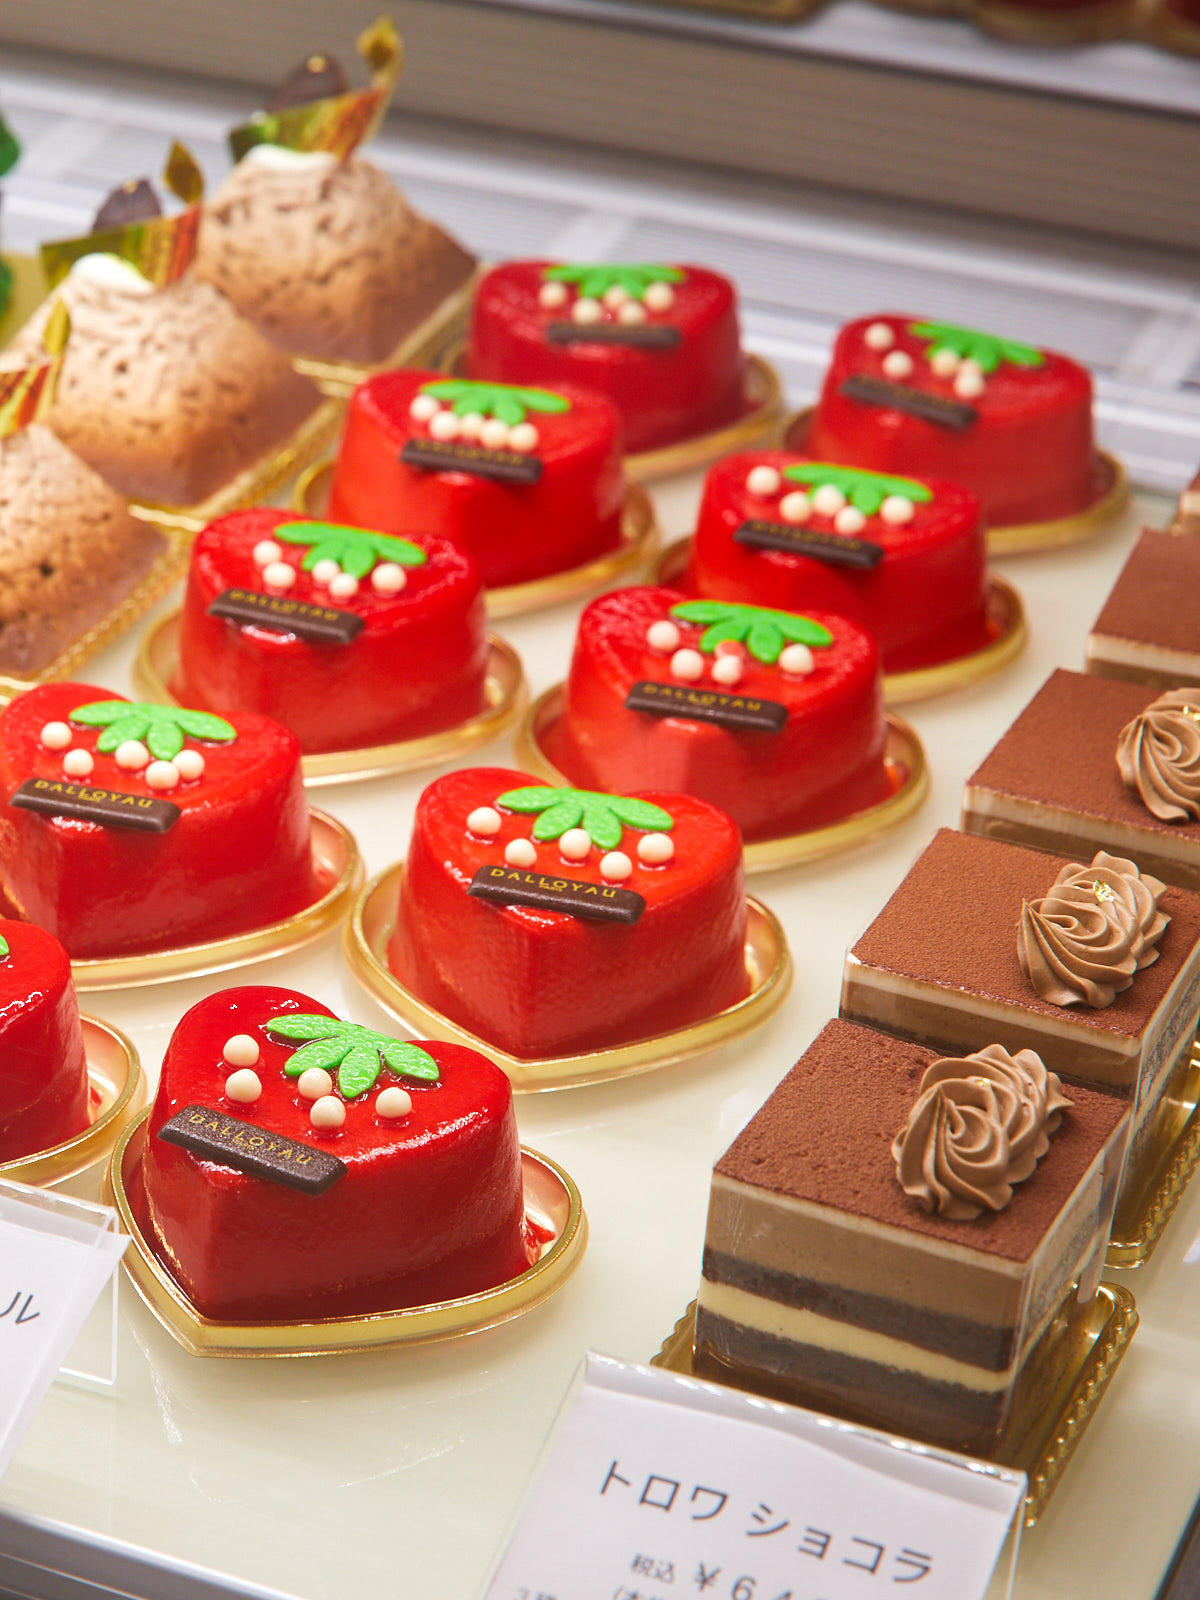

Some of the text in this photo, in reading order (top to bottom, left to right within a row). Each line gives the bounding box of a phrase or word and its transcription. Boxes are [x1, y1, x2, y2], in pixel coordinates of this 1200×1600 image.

[34, 779, 153, 808] DALLOYAU
[490, 868, 616, 898] DALLOYAU
[189, 1114, 312, 1165] DALLOYAU
[599, 1460, 933, 1584] トロワ ショコラ
[631, 1553, 675, 1584] 税込
